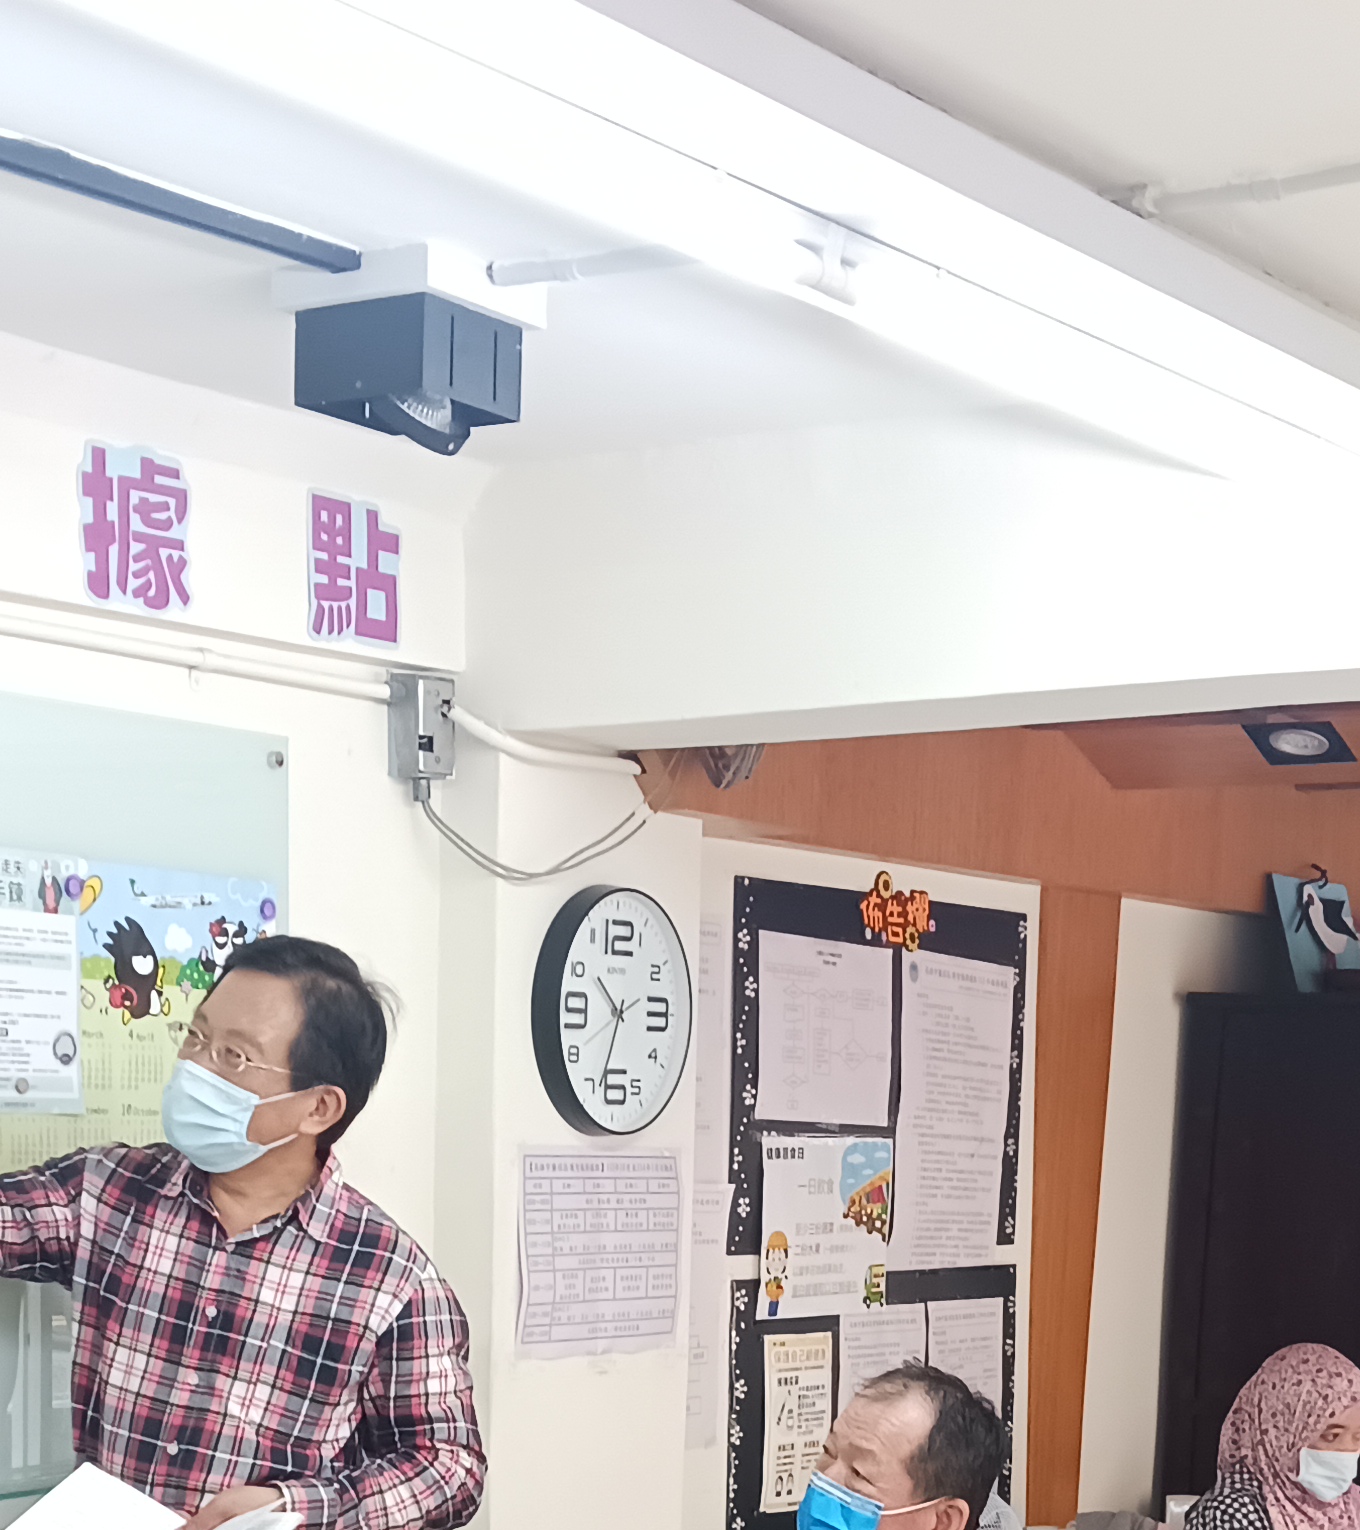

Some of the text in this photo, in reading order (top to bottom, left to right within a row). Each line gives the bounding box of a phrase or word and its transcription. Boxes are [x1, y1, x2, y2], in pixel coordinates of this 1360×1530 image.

[604, 918, 635, 958] 12
[570, 961, 585, 978] 10
[650, 963, 661, 982] 2
[563, 990, 589, 1029] 9
[646, 995, 670, 1033] 3
[567, 1044, 580, 1064] 8
[647, 1047, 658, 1064] 4
[584, 1077, 595, 1095] 7
[603, 1068, 628, 1106] 6
[630, 1078, 642, 1096] 5
